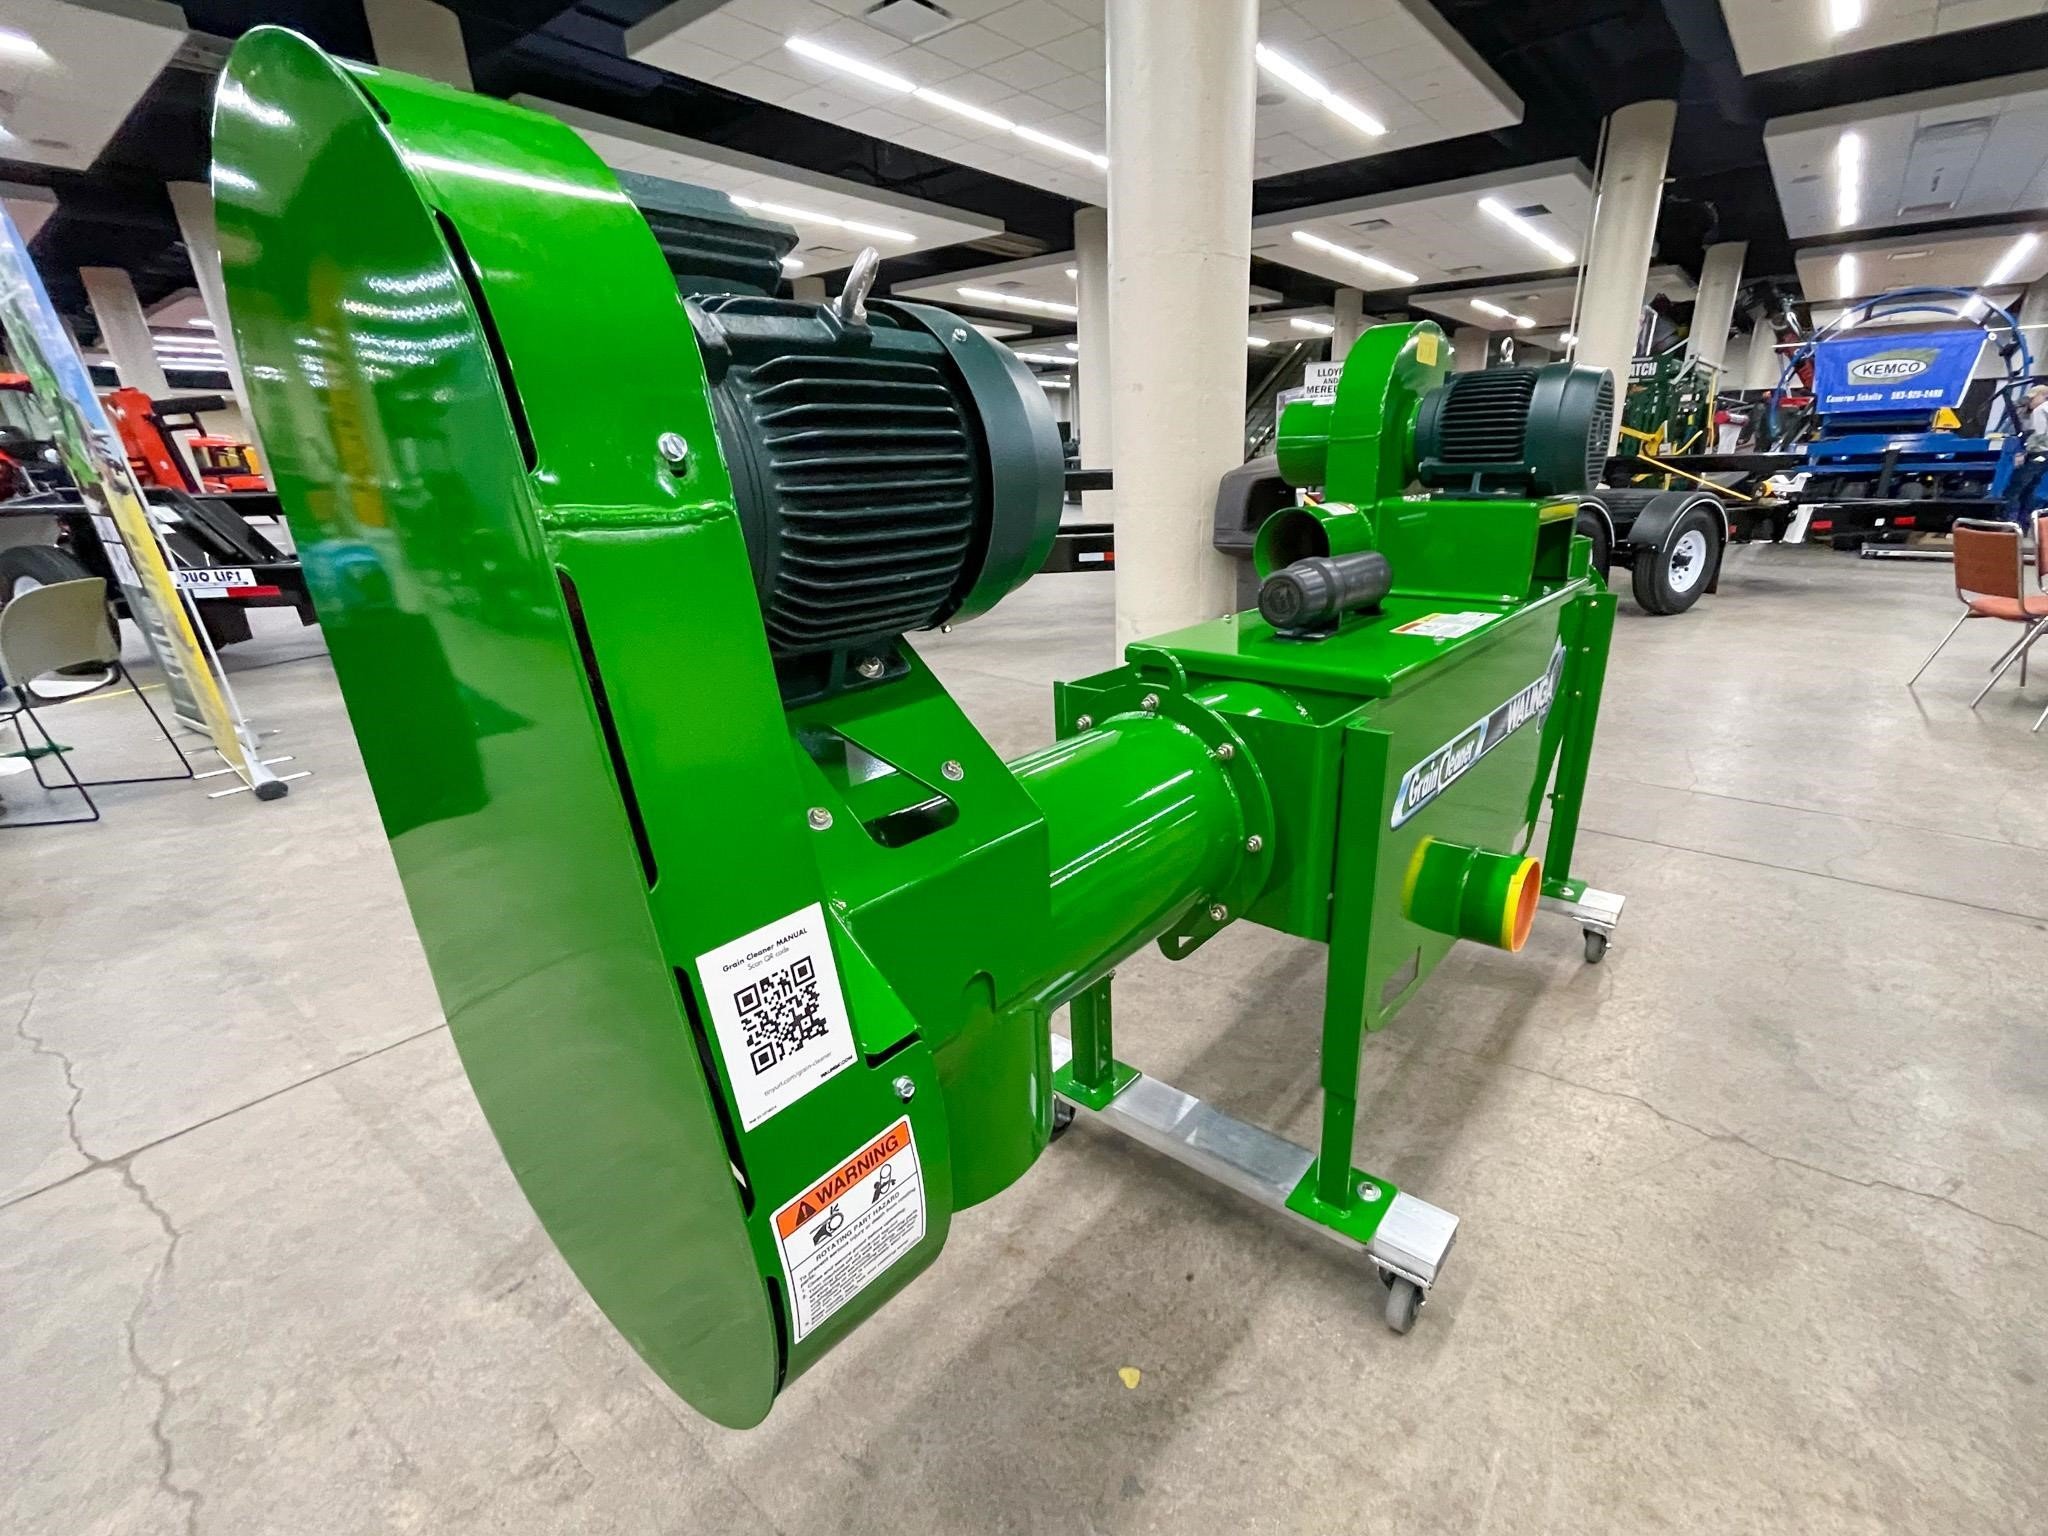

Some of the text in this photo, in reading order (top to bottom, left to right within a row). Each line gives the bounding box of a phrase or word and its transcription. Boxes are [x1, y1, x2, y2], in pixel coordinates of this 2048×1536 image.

[1863, 362, 1921, 375] KEMCO
[1408, 761, 1440, 807] Grain
[1438, 739, 1476, 794] Cleaner
[722, 927, 808, 973] Grain Cleaner MANUAL
[747, 946, 790, 971] Scan QR code
[815, 1134, 899, 1205] WARNING
[815, 1190, 899, 1262] ROTATING PART HAZARD
